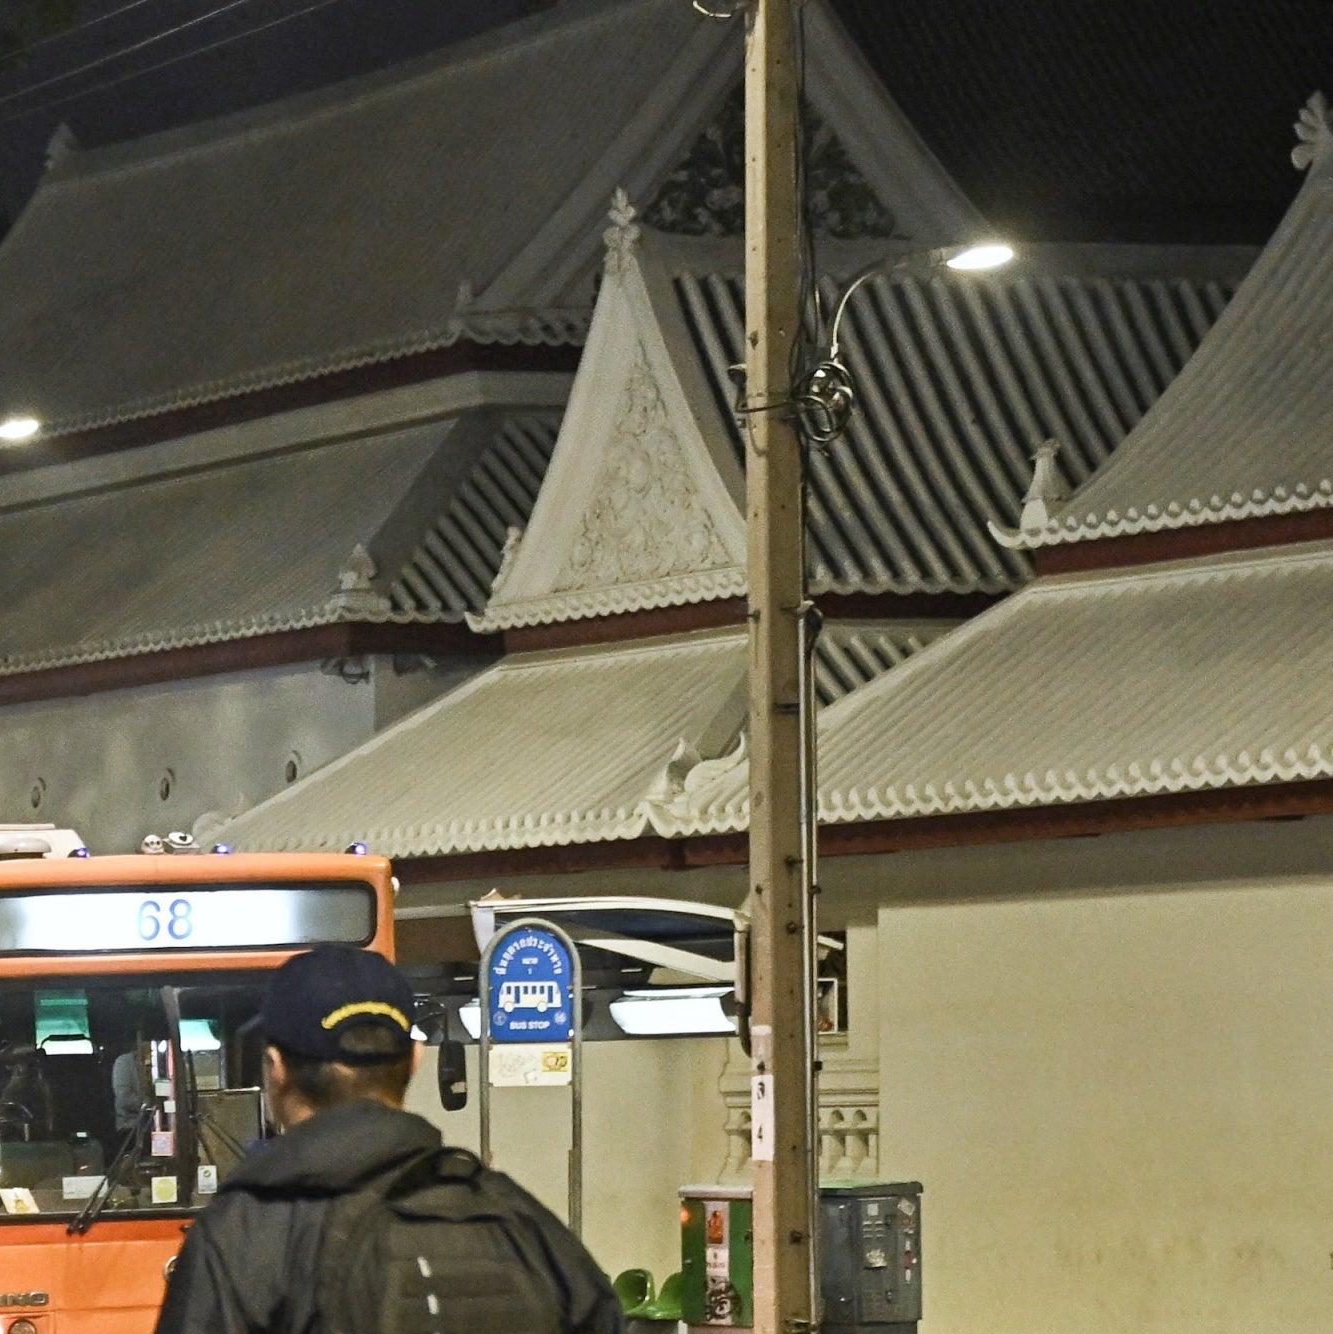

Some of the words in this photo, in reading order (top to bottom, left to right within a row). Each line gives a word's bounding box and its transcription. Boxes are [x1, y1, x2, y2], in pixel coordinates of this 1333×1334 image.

[138, 898, 193, 941] 68
[509, 1021, 527, 1030] BUS
[528, 1020, 551, 1030] STOP
